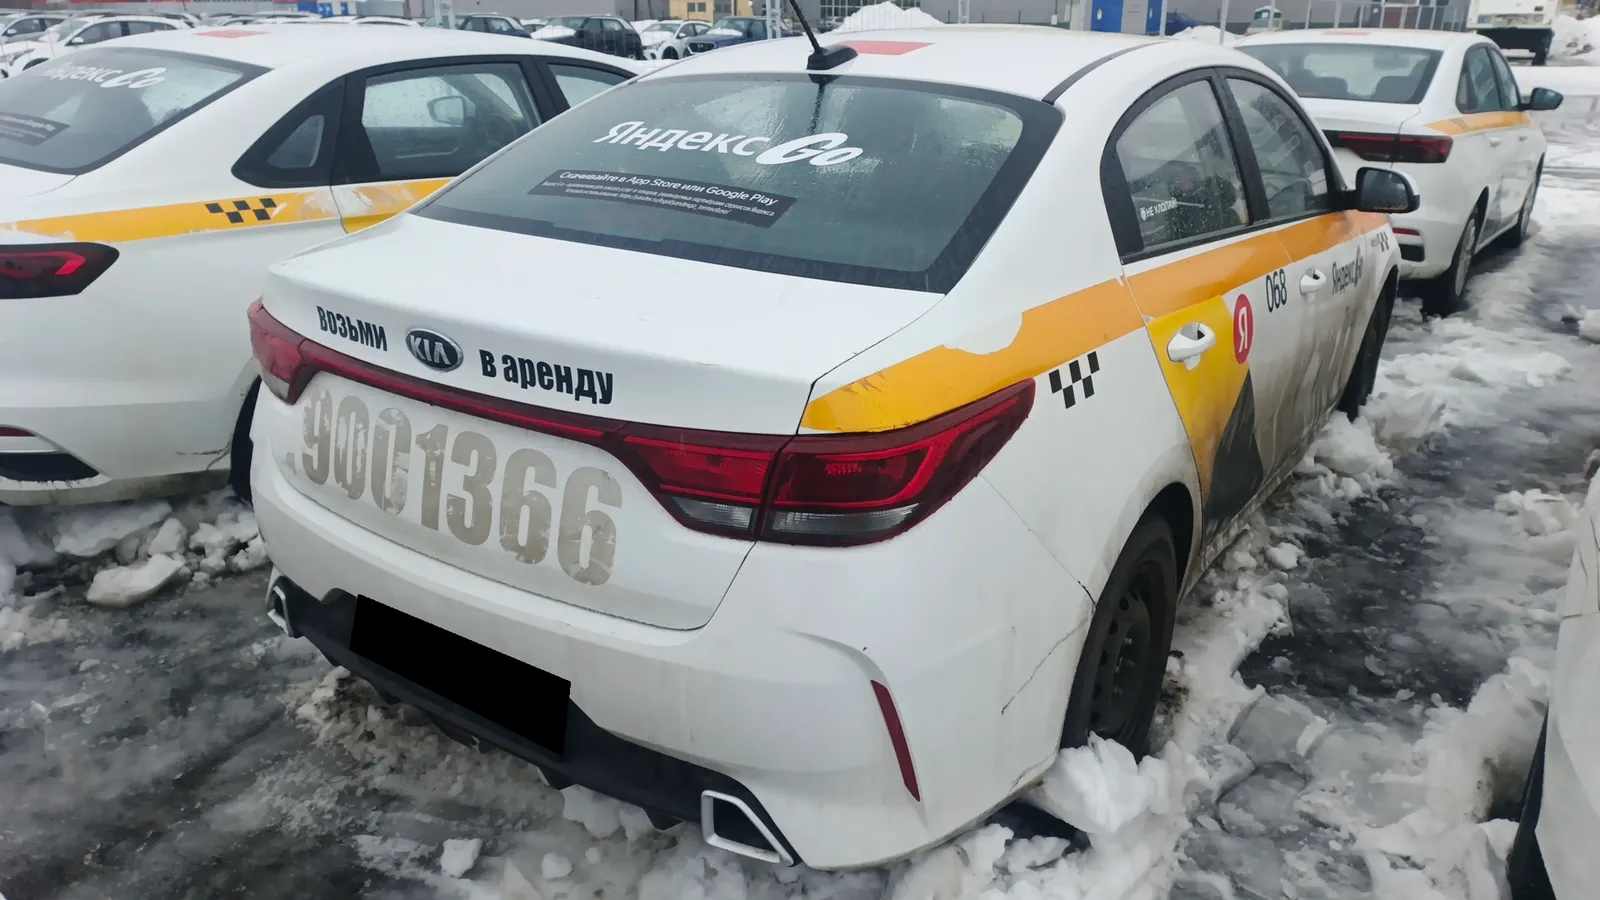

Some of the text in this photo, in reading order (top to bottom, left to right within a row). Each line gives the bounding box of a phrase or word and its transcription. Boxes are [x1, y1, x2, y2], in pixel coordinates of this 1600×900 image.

[592, 120, 864, 166] Яндекс Go
[560, 171, 779, 206] Скачивайте в App Store или Google Play
[1265, 268, 1288, 313] 068
[408, 334, 452, 366] KIA
[479, 349, 614, 405] в аренду
[301, 387, 623, 586] 9001366
